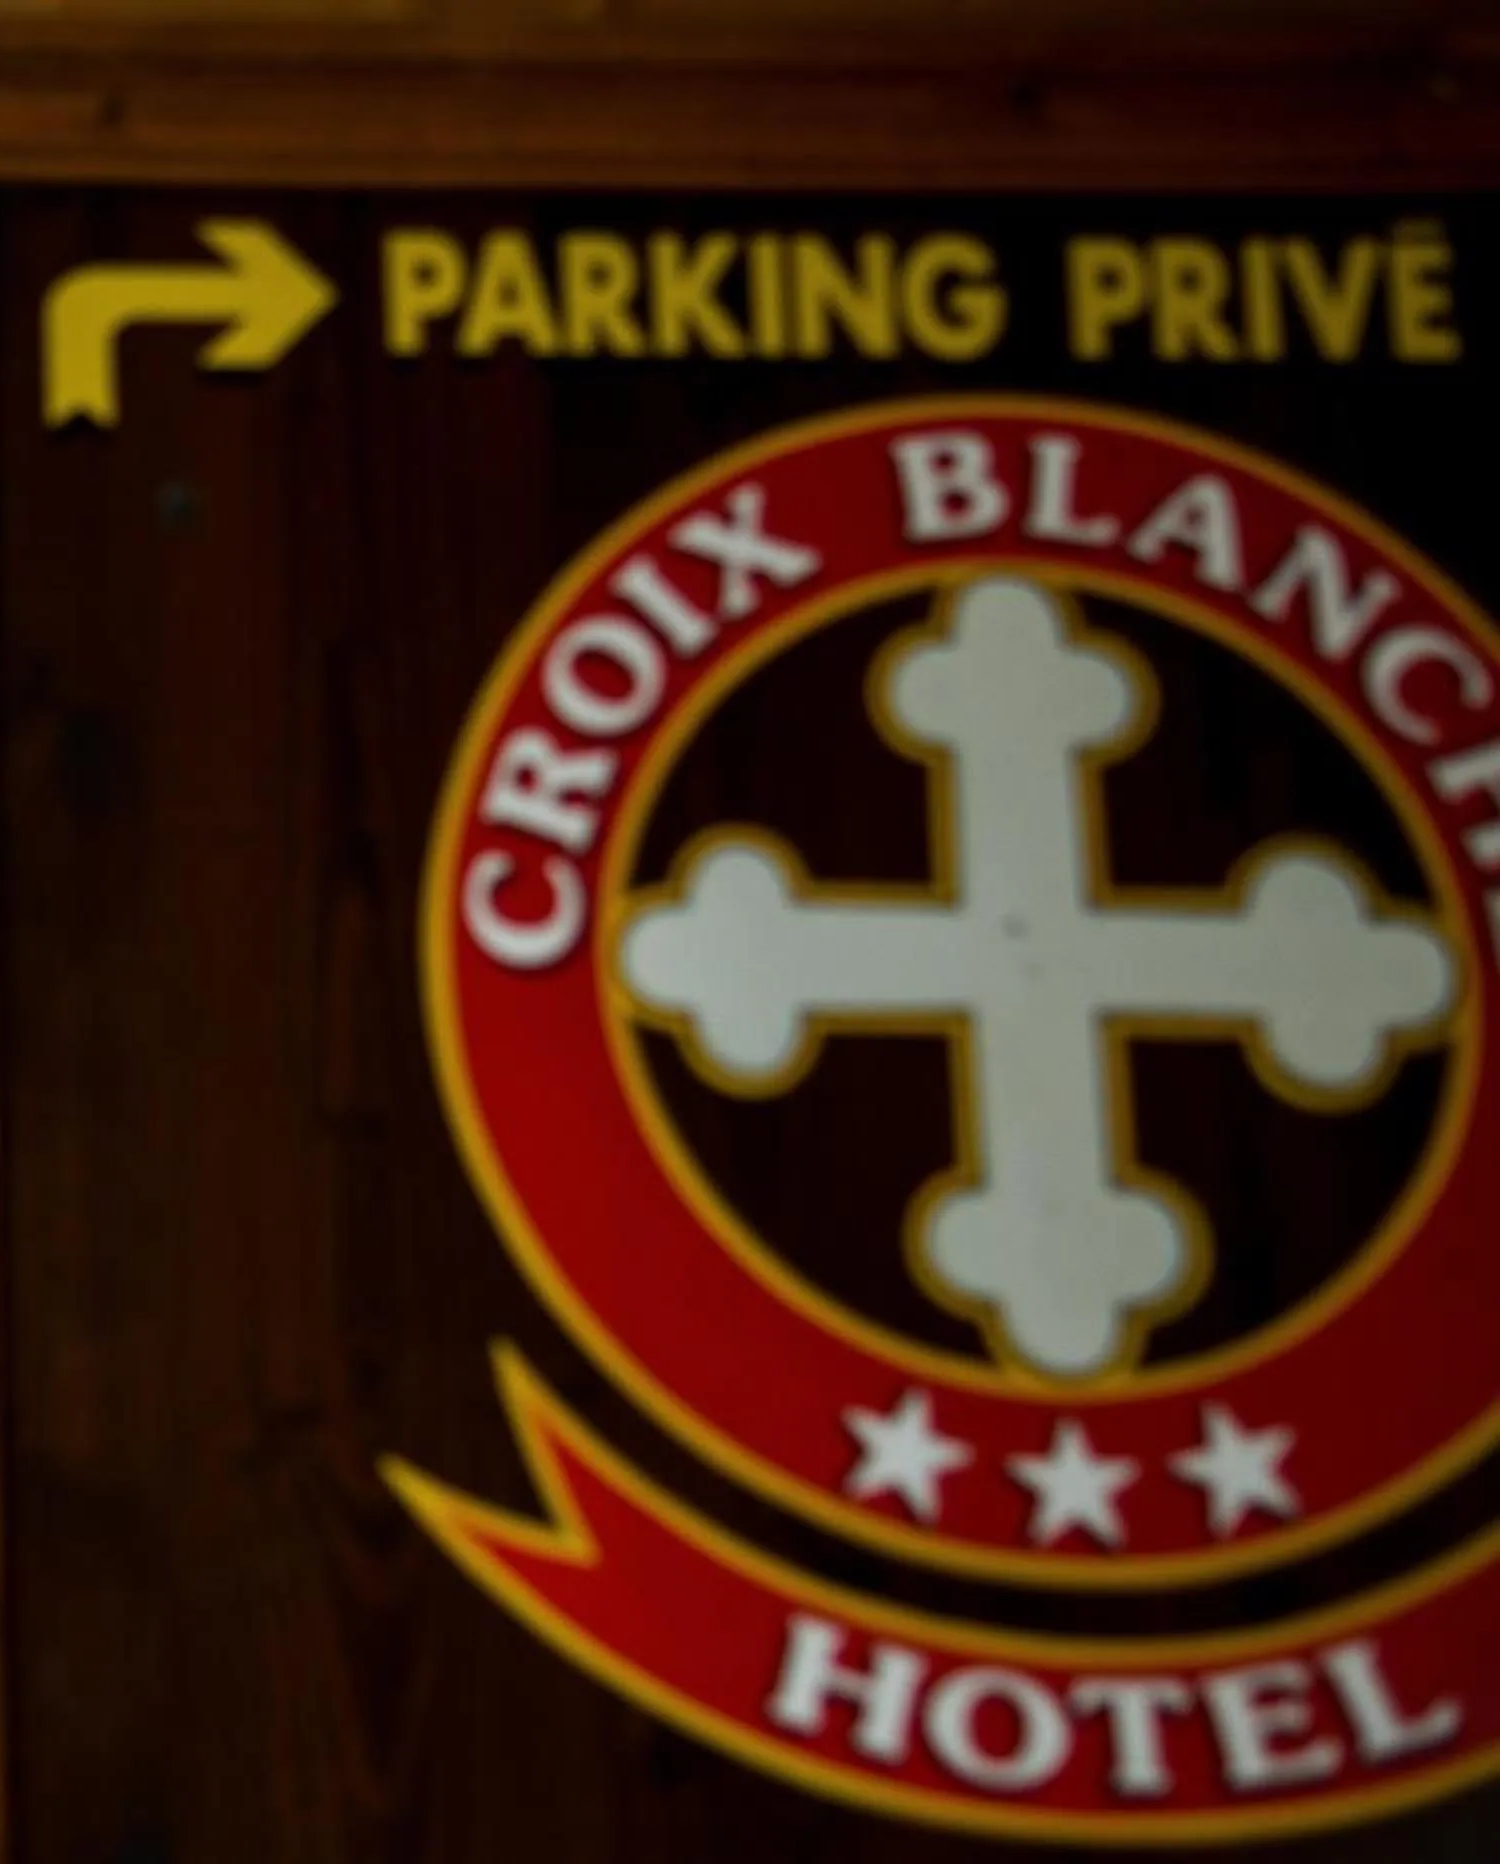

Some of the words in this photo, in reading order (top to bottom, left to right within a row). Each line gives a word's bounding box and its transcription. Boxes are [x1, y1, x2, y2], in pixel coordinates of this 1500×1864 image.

[381, 229, 1008, 359] PARKING
[1065, 216, 1463, 363] PRIVÉ
[462, 480, 821, 969] CROIX
[888, 428, 1500, 978] BLANC
[766, 1611, 1462, 1797] HOTEL
